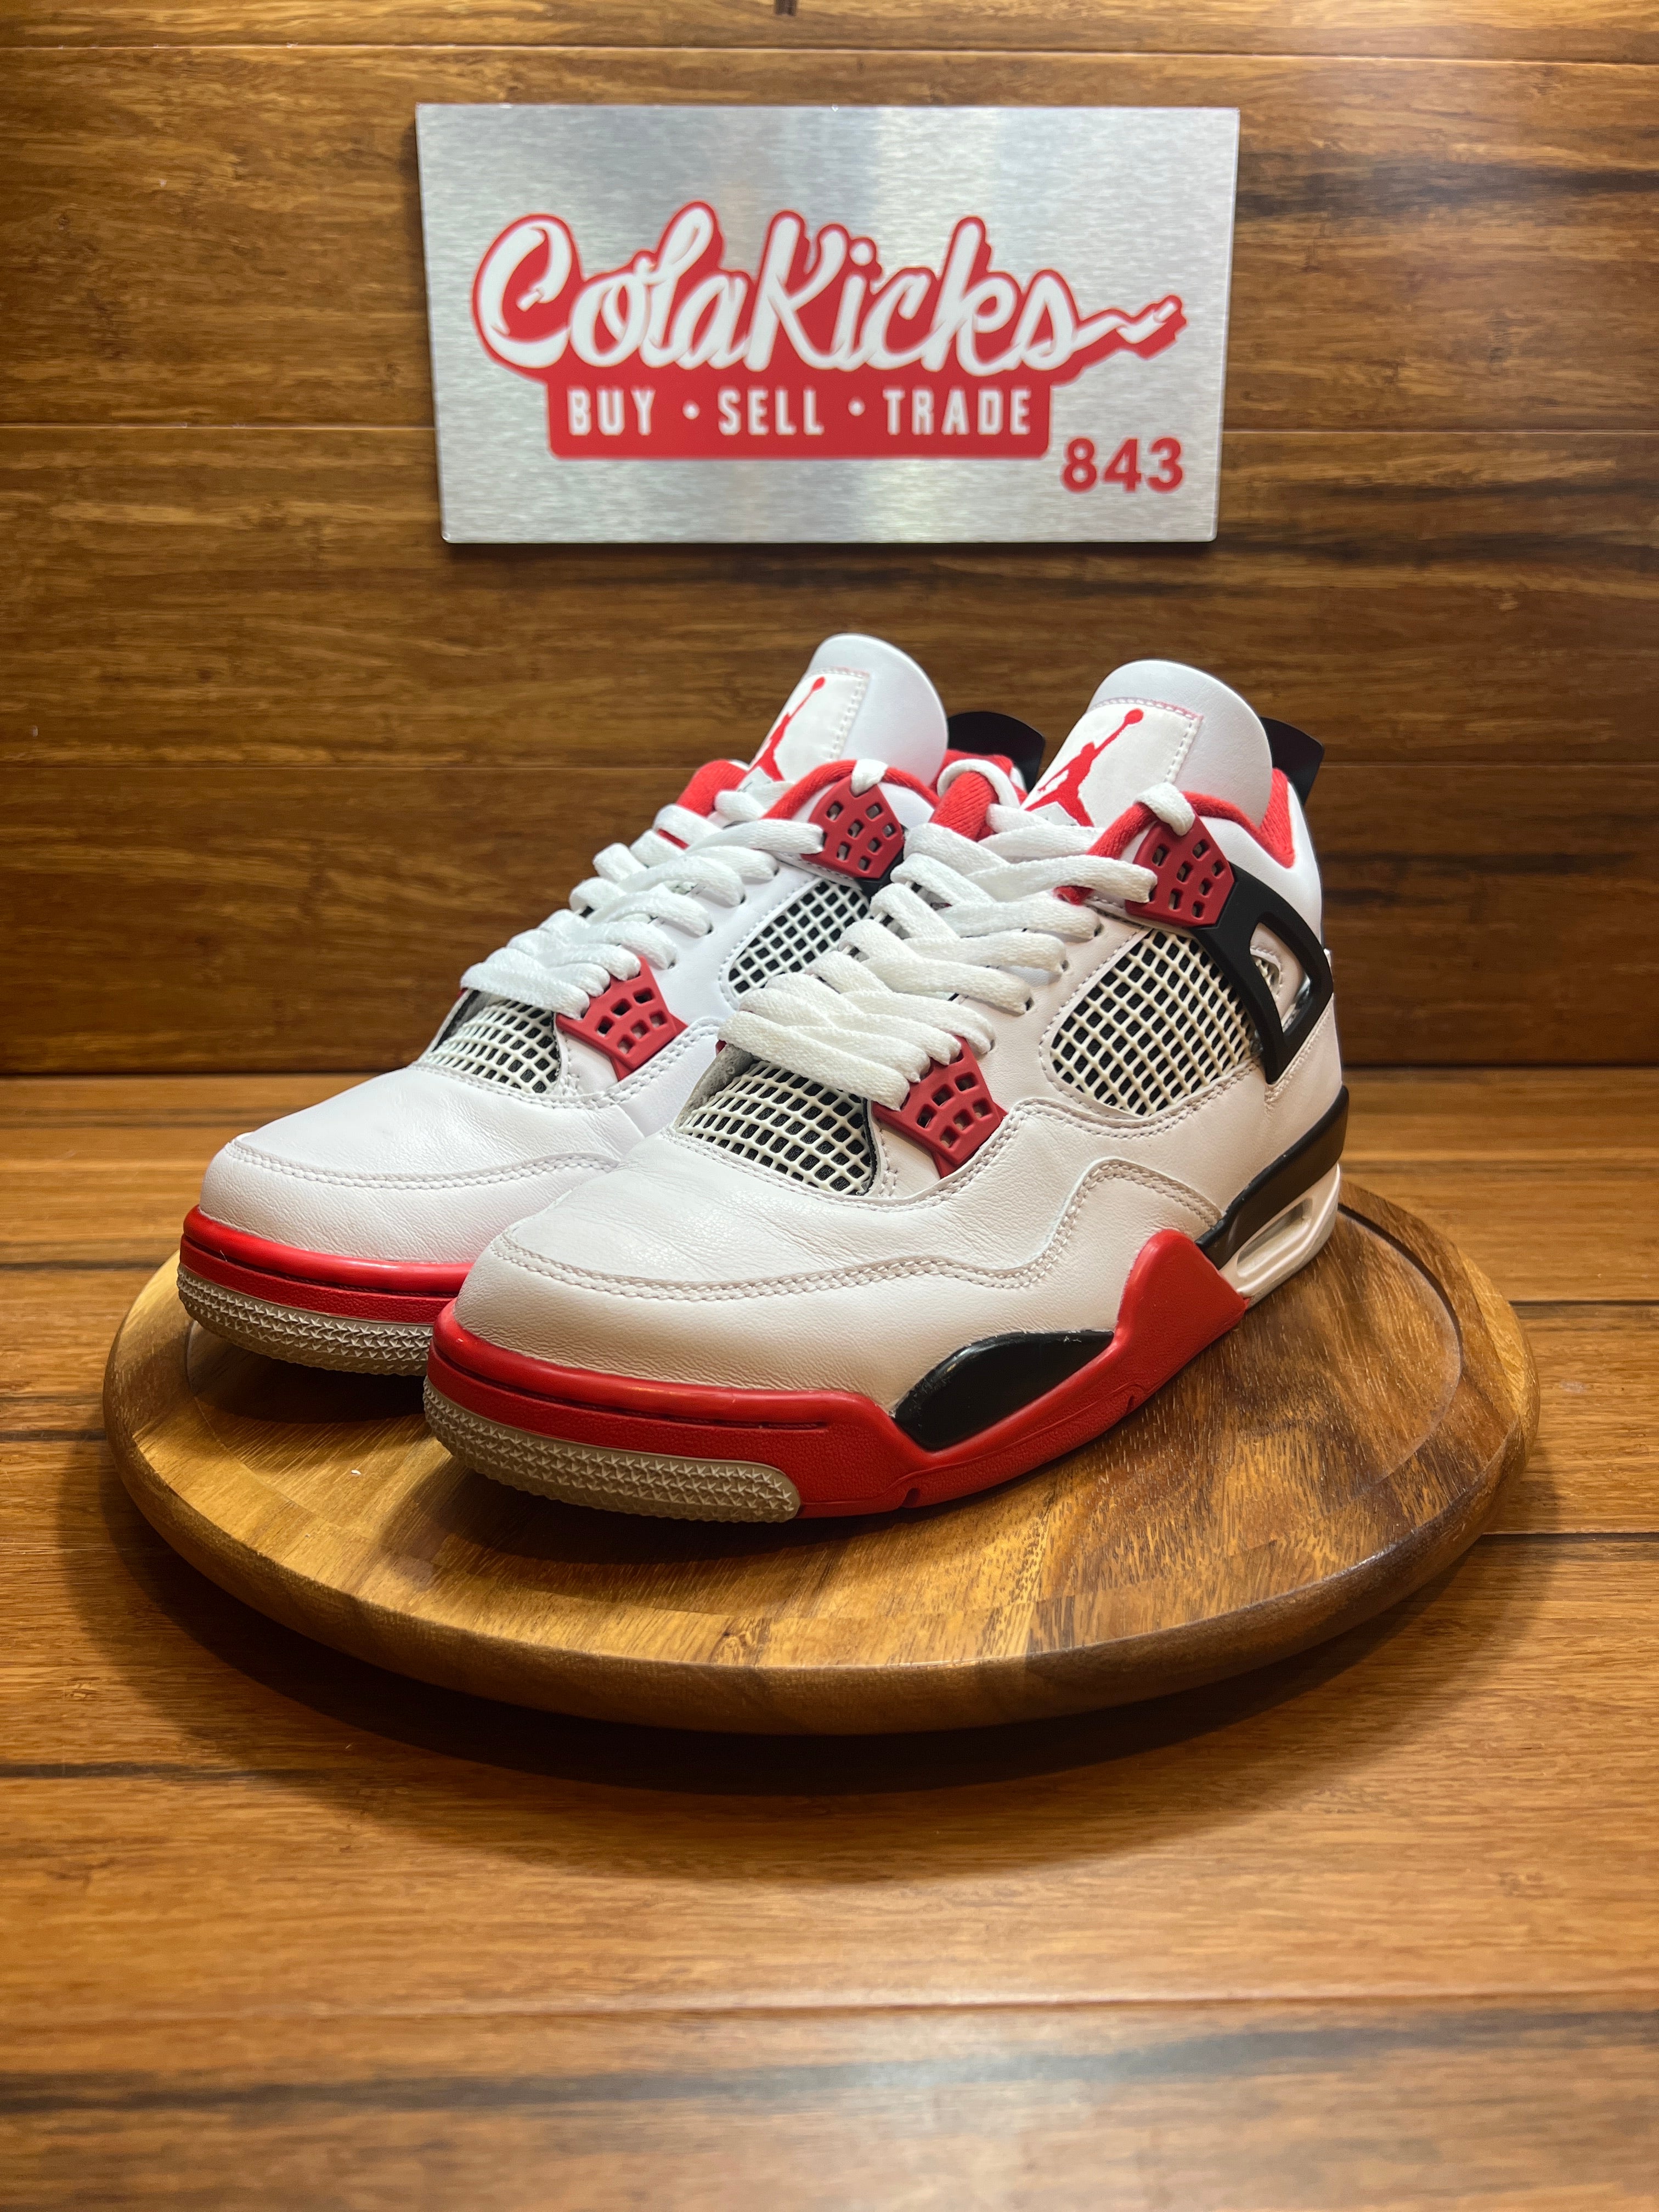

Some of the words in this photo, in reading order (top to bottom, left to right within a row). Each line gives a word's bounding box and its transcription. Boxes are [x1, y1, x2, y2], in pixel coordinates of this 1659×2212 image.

[474, 204, 1184, 374] ColaKicks
[567, 389, 656, 436] BUY
[718, 390, 824, 436] SELL
[883, 388, 1032, 436] TRADE
[1062, 437, 1184, 493] 843
